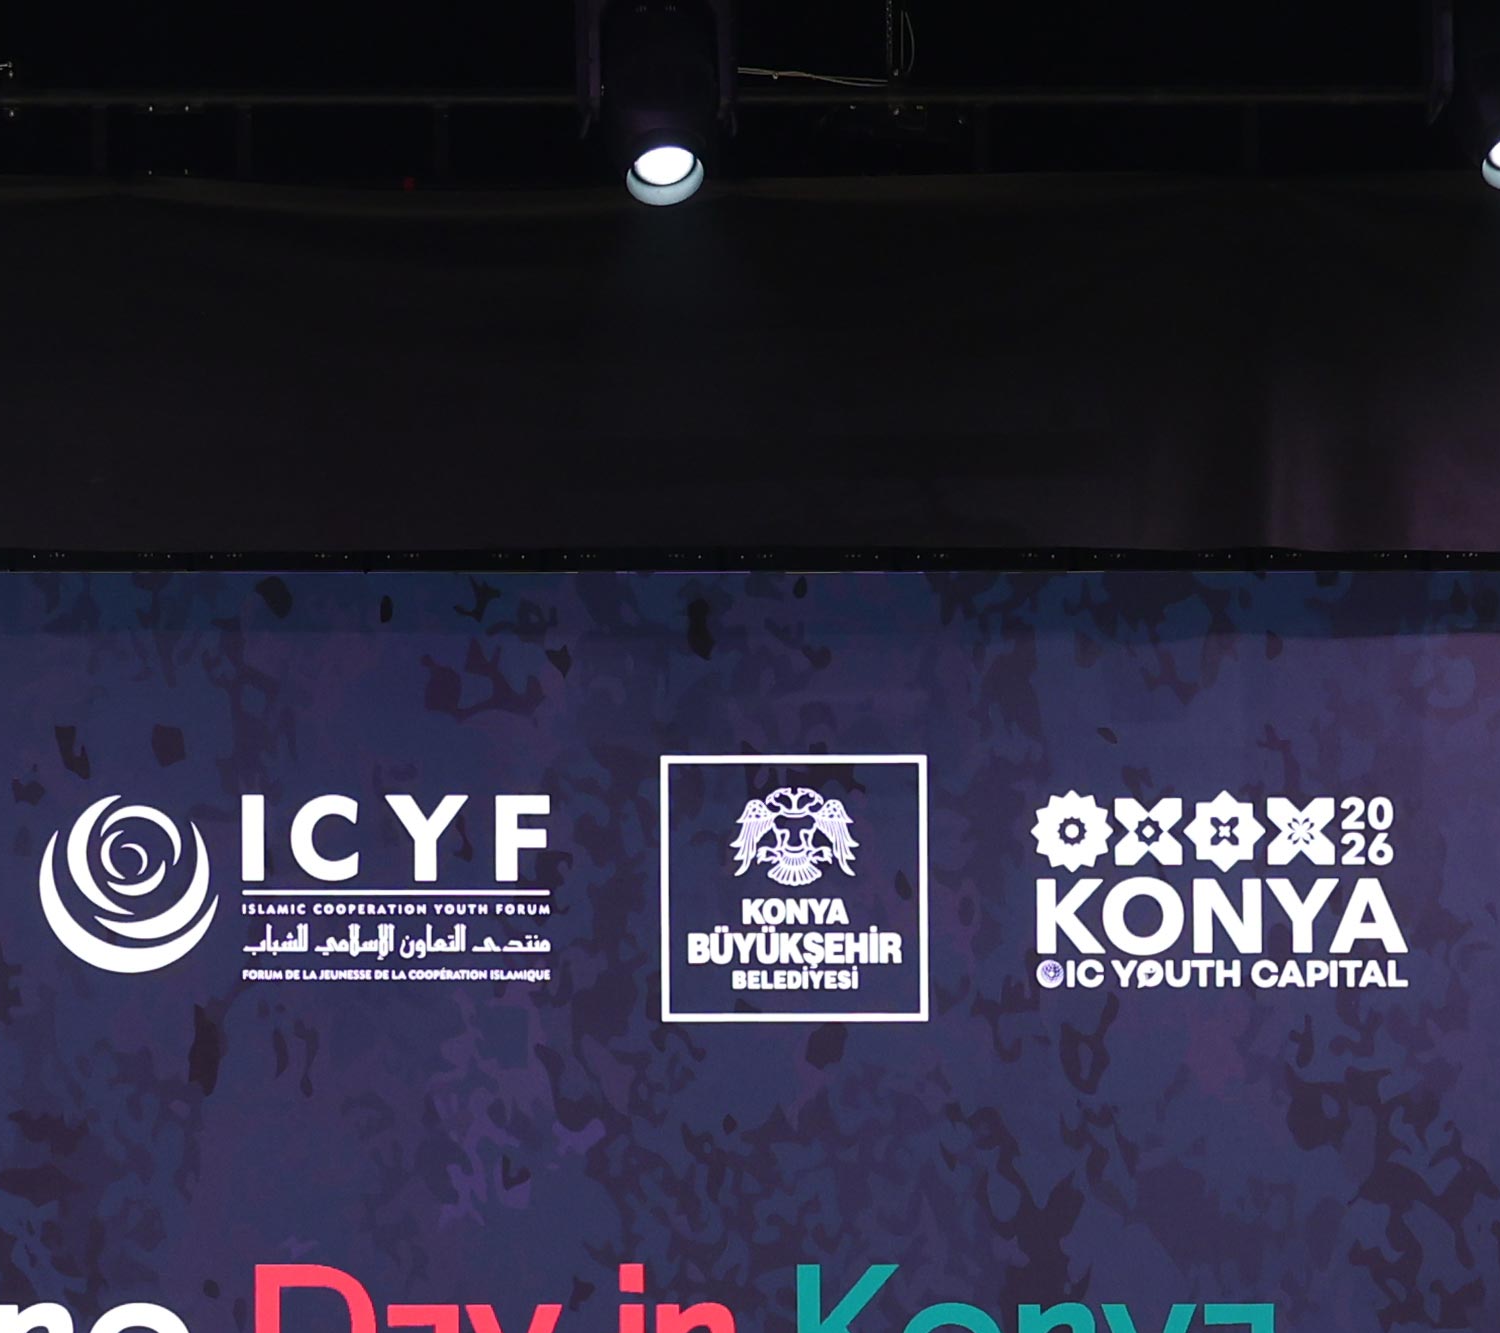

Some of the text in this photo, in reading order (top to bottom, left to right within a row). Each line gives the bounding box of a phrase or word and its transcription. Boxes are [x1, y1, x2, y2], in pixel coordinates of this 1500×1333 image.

[1340, 796, 1394, 831] 20
[242, 794, 551, 882] ICYF
[1340, 833, 1394, 866] 26
[241, 903, 551, 916] ISLAMIC COOPERATION YOUTH FORUM
[741, 897, 850, 926] KONYA
[1036, 877, 1409, 955] KONYA
[243, 923, 309, 957] للشباب
[399, 923, 467, 959] التعاون
[471, 934, 551, 953] منتدى
[687, 925, 903, 972] BÜYÜKŞEHİR
[242, 967, 551, 982] FORUM DE LA JEUNESSE DE LA COOPÉRATION ISLAMIQUE
[731, 967, 859, 990] BELEDİYESİ
[1110, 959, 1242, 990] YOUTH
[1250, 959, 1409, 989] CAPITAL
